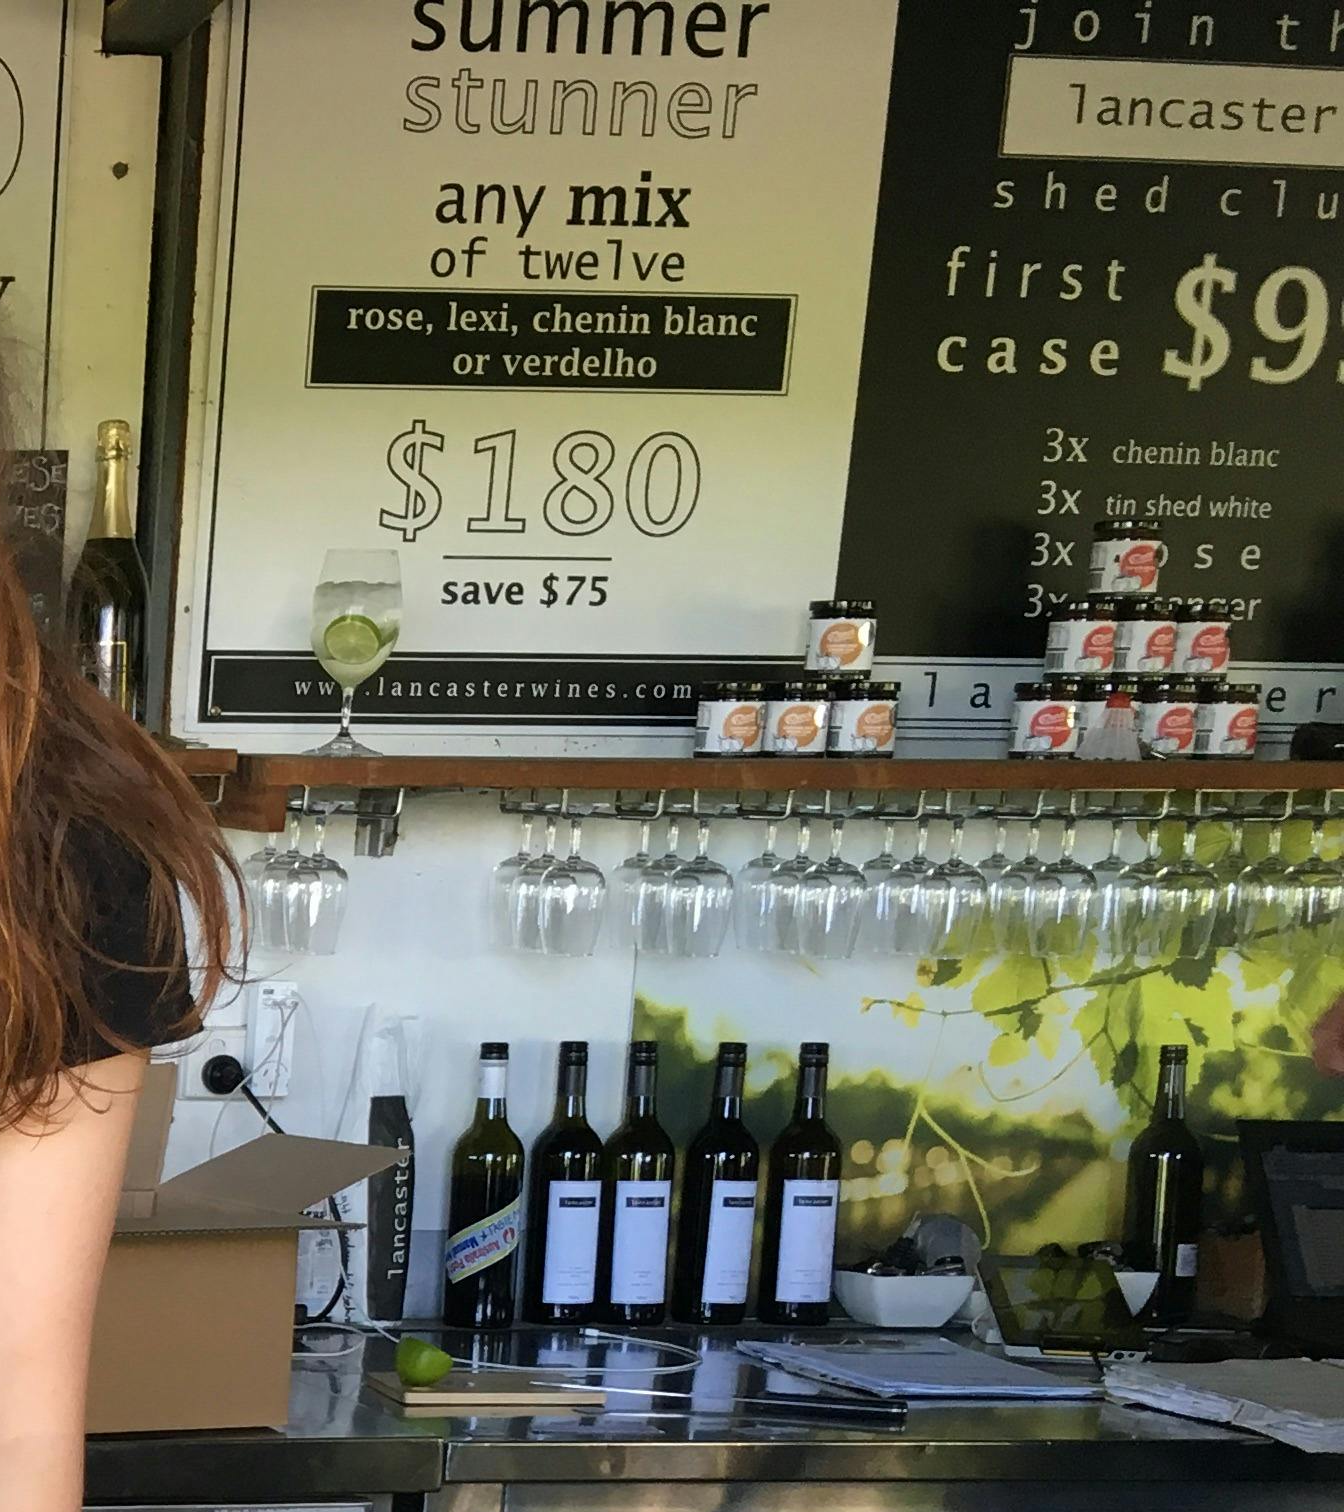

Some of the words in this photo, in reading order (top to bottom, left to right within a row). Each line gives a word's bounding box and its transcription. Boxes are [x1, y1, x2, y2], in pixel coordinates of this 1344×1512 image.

[411, 0, 770, 58] summer
[1013, 0, 1215, 51] join
[402, 67, 759, 139] stunner
[1068, 83, 1337, 135] lancaster
[434, 179, 547, 239] any
[565, 170, 691, 229] mix
[993, 171, 1171, 214] shed
[429, 236, 489, 279] of
[518, 239, 686, 283] twelve
[946, 245, 1126, 301] first
[346, 303, 433, 337] rose,
[446, 301, 518, 337] lexi,
[532, 304, 651, 337] chenin
[663, 304, 759, 338] blanc
[1162, 252, 1344, 392] $9
[452, 352, 490, 376] or
[502, 346, 657, 378] verdelho
[936, 334, 1120, 376] case
[1042, 427, 1089, 464] 3x
[1112, 439, 1200, 467] chenin
[1209, 441, 1280, 469] blanc
[378, 419, 701, 543] $180
[1037, 480, 1082, 515] 3x
[1105, 494, 1137, 516] tin
[1145, 494, 1200, 518] shed
[1209, 495, 1272, 520] white
[1029, 532, 1075, 567] 3x
[440, 579, 524, 607] save
[538, 574, 610, 608] $75
[386, 1137, 411, 1280] lancaster
